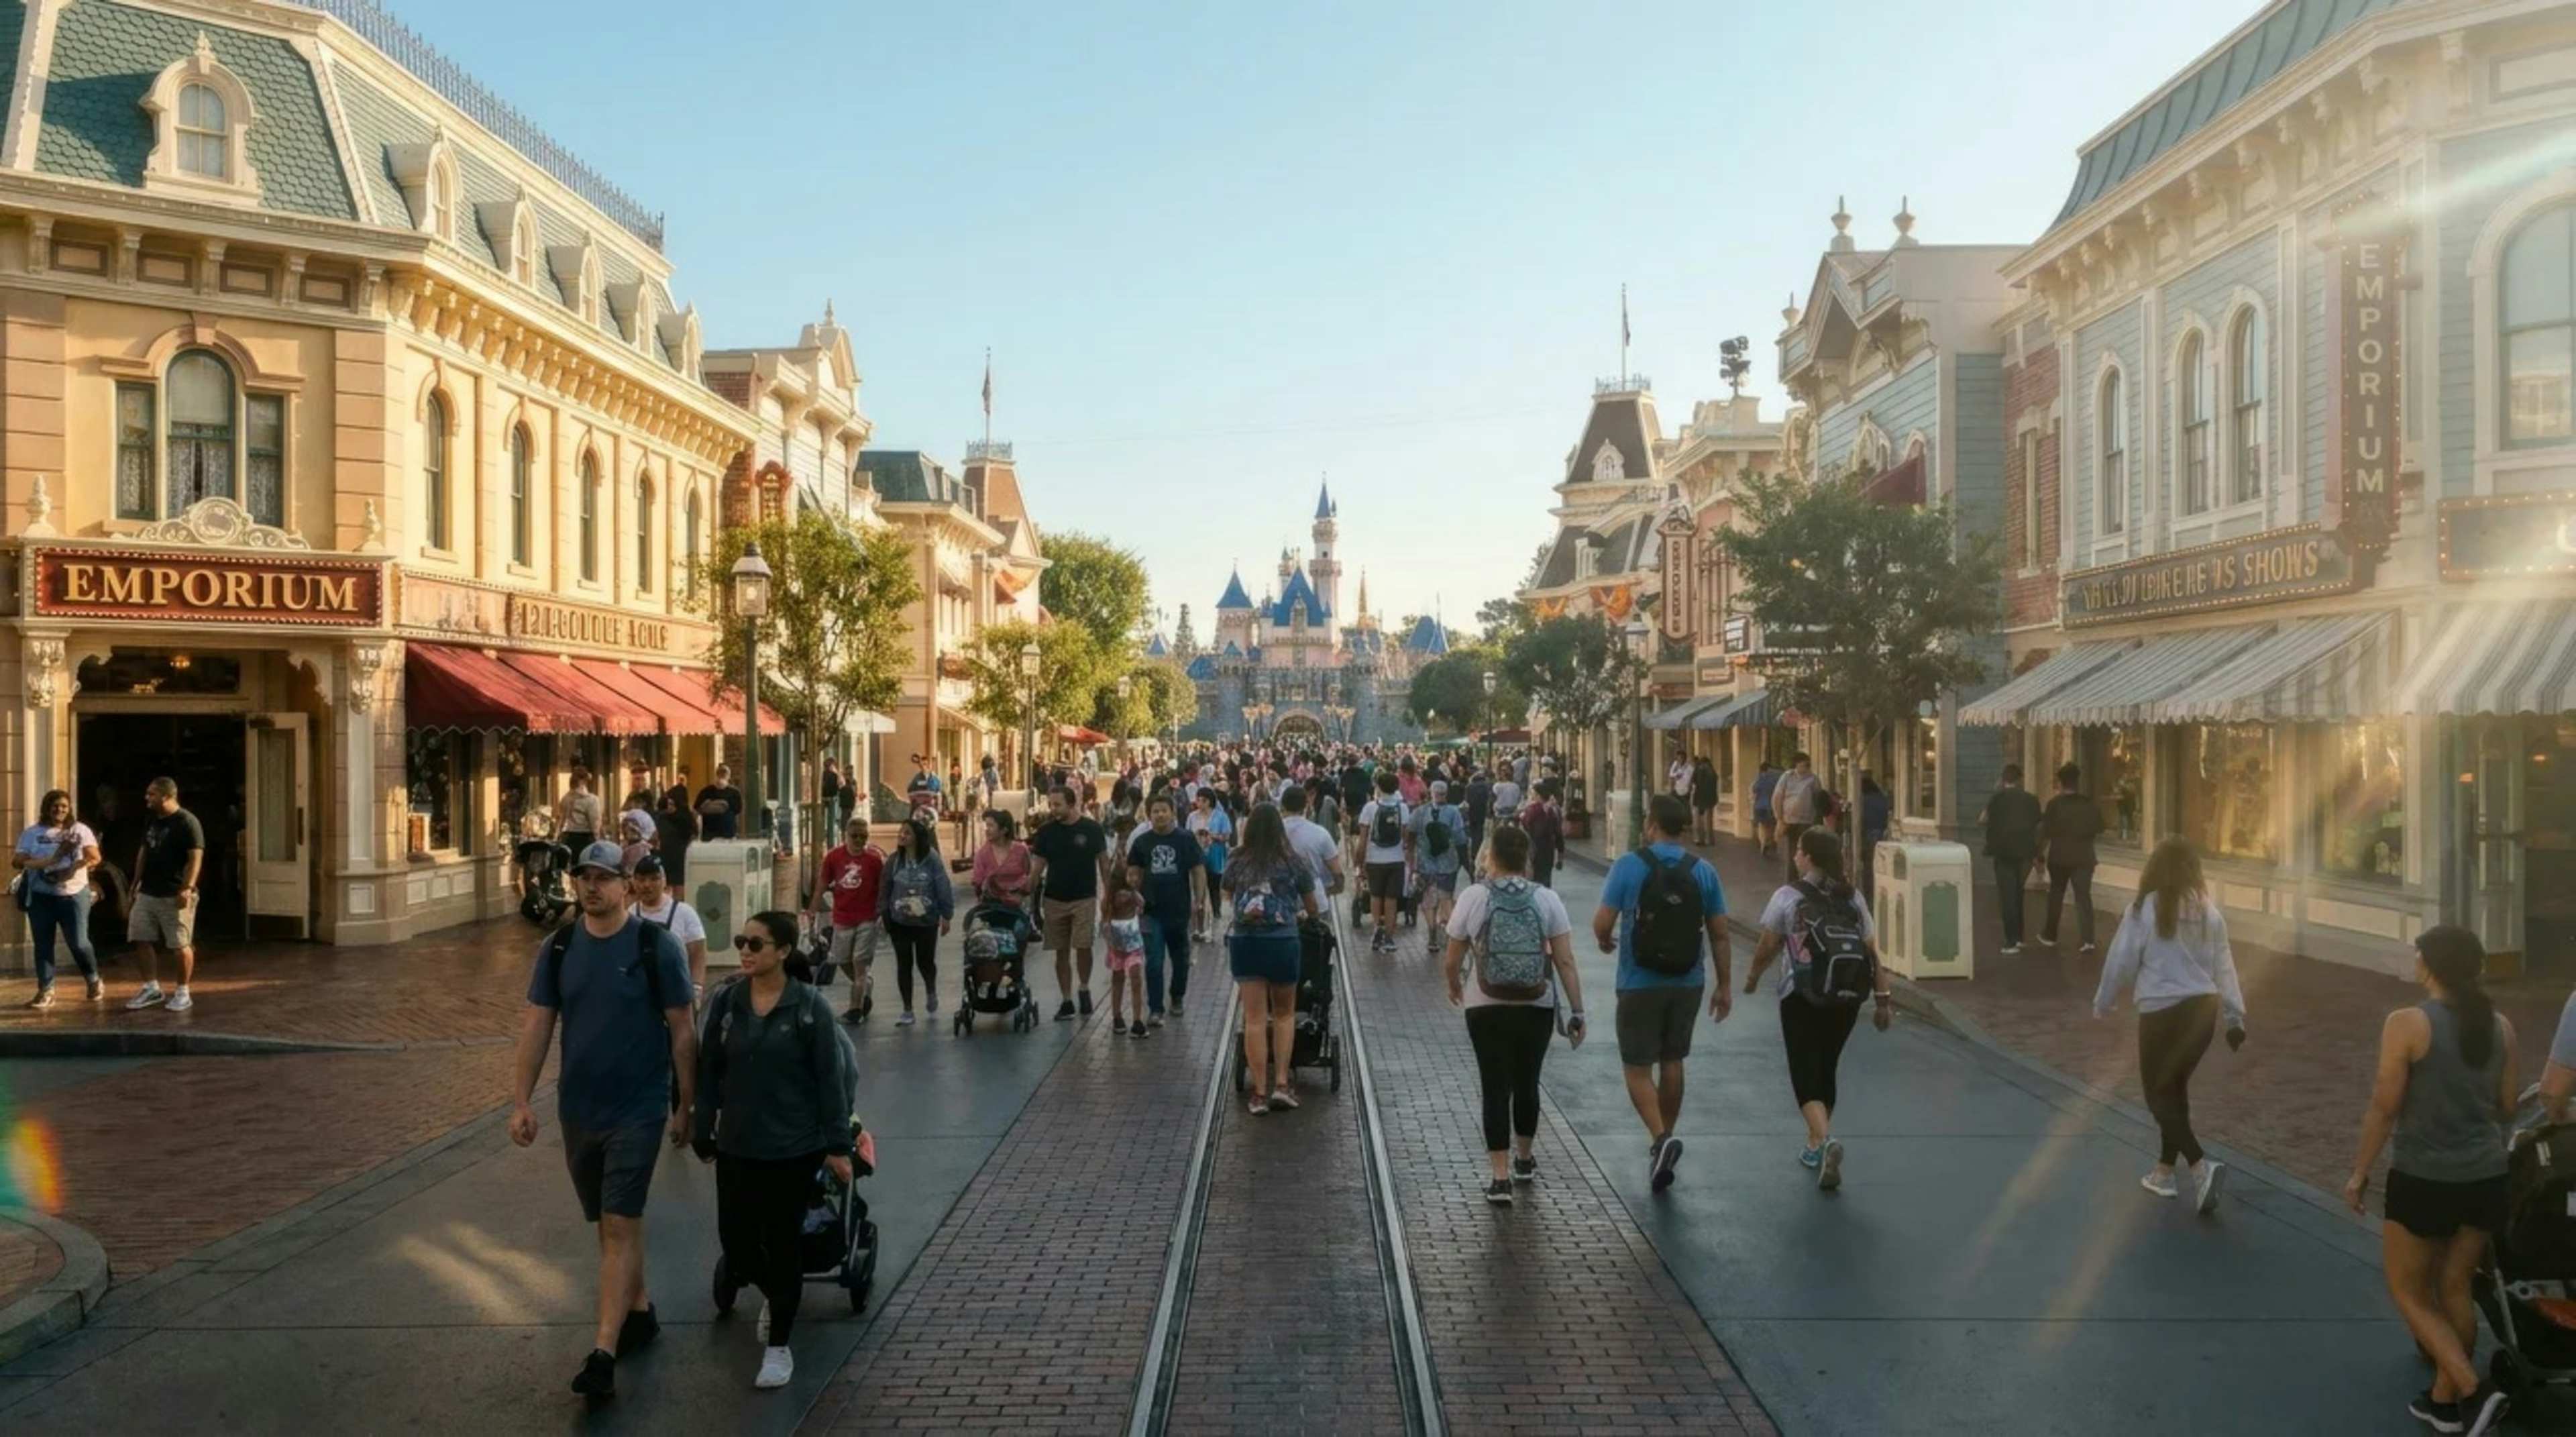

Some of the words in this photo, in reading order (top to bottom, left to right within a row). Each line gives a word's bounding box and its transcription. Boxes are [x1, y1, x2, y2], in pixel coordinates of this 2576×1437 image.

[2357, 244, 2384, 493] EMPORIUM
[63, 564, 359, 611] EMPORIUM
[2243, 541, 2319, 587] SHOWS
